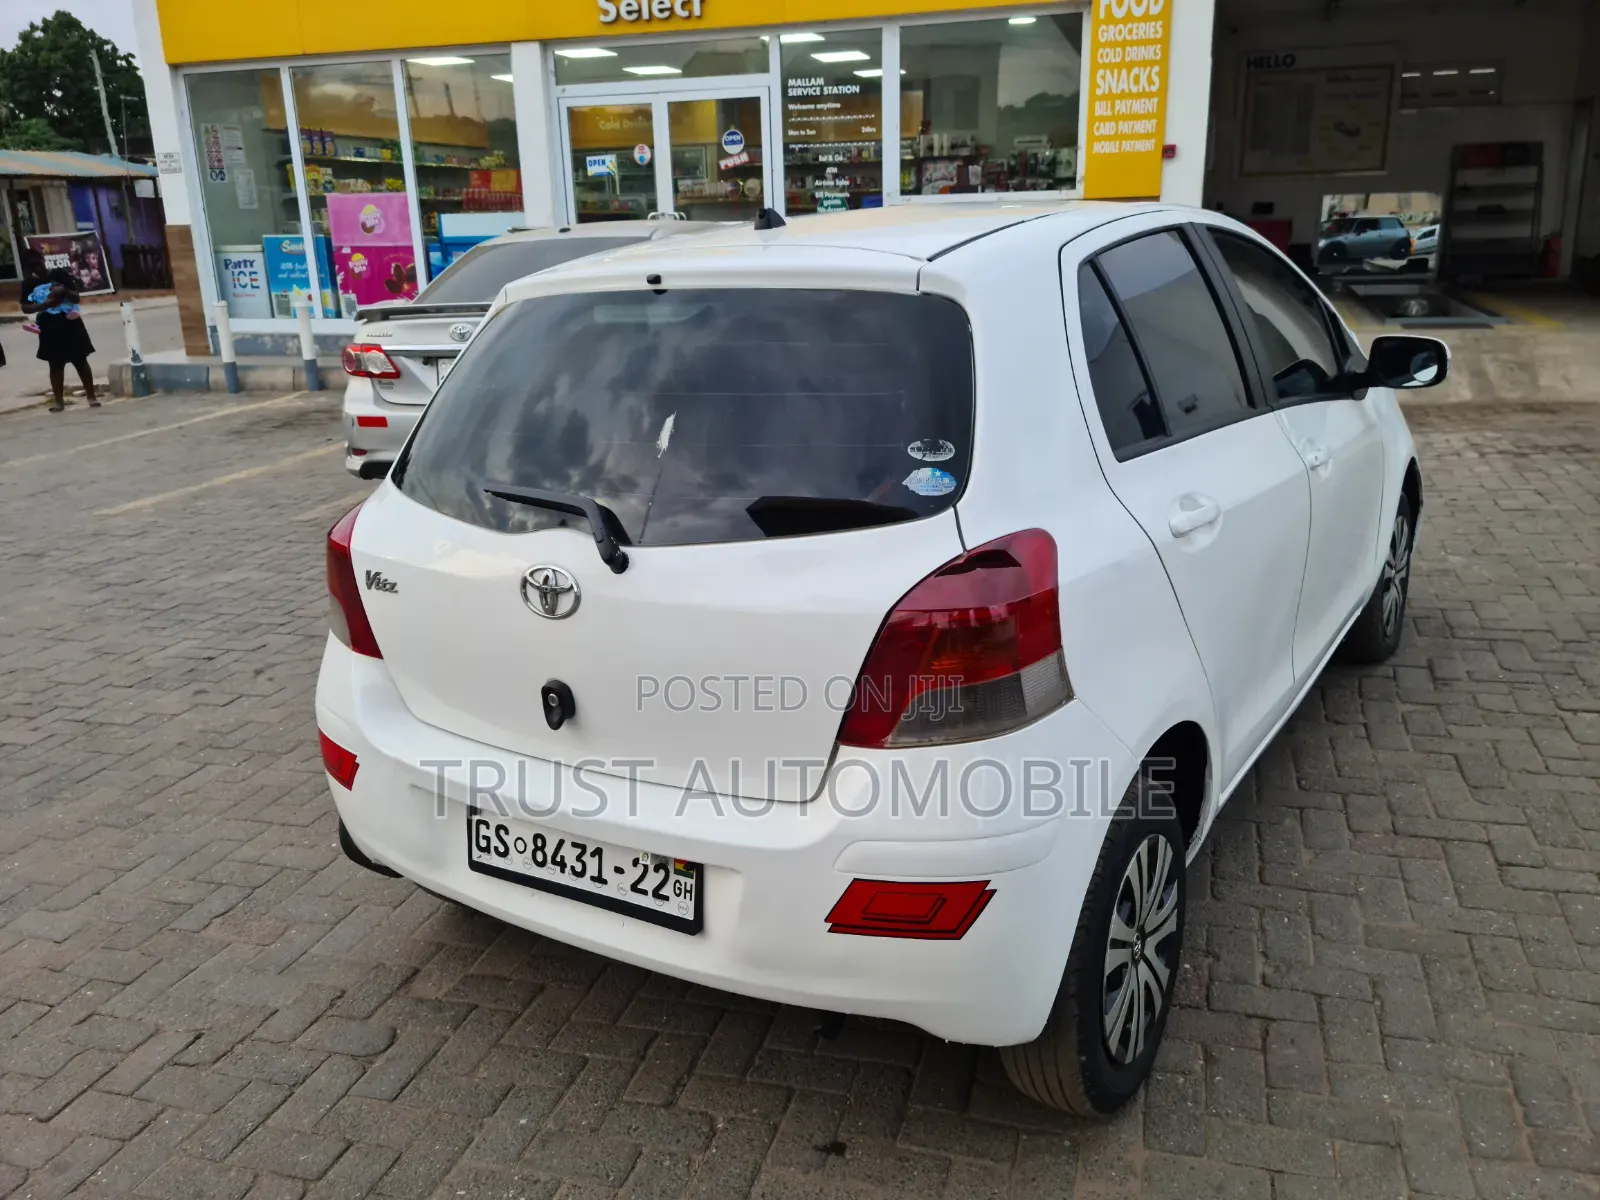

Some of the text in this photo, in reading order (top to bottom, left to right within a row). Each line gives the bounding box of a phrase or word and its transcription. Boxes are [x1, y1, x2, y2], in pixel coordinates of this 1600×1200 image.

[598, 0, 705, 23] Select
[1100, 0, 1165, 20] FOOD
[1098, 21, 1162, 43] GROCERIES
[1097, 44, 1162, 64] COLD DRINKS
[1246, 54, 1296, 69] HELLO
[788, 77, 824, 87] MALLAM
[1096, 65, 1160, 96] SNACKS
[788, 84, 860, 96] SERVICE STATION
[816, 102, 841, 111] anytime
[1095, 98, 1158, 116] BILL PAYMENT
[599, 120, 620, 130] Cold
[1094, 119, 1157, 136] CARD PAYMENT
[1093, 140, 1119, 154] MOBILE
[1121, 139, 1156, 152] PAYMENT
[588, 158, 606, 168] OPEN
[718, 152, 749, 171] PUSH
[223, 258, 256, 271] Party
[231, 271, 260, 289] ICE
[365, 569, 398, 594] Vitz
[475, 818, 510, 858] GS
[673, 879, 693, 901] GH
